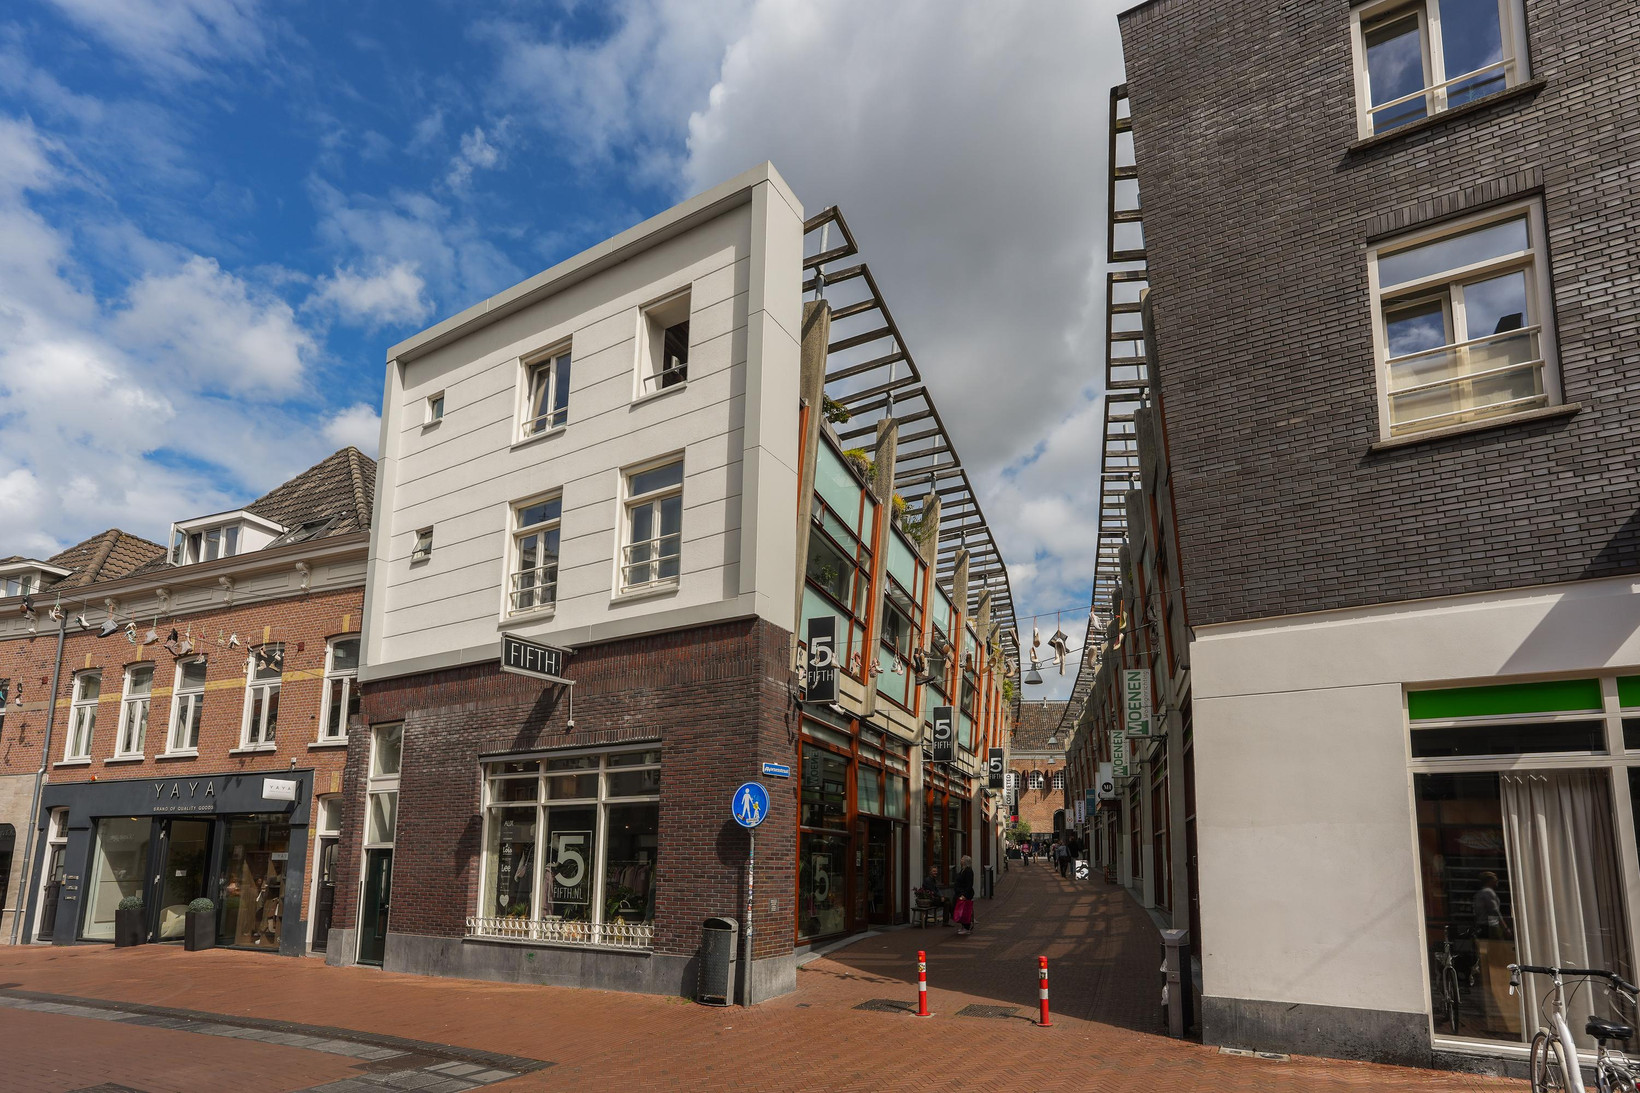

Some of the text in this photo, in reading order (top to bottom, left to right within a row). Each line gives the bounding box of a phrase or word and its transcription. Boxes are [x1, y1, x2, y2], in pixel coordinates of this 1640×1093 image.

[810, 636, 832, 667] 5
[1127, 671, 1142, 736] MOENEN
[934, 719, 951, 740] 5
[934, 741, 951, 749] FIFTH
[1113, 731, 1124, 776] MOENEN
[989, 757, 1003, 773] 5
[155, 781, 215, 797] YAYA
[501, 864, 512, 873] Lee
[555, 835, 585, 887] 5
[814, 855, 829, 901] 5
[553, 887, 583, 900] FIFTH.NL
